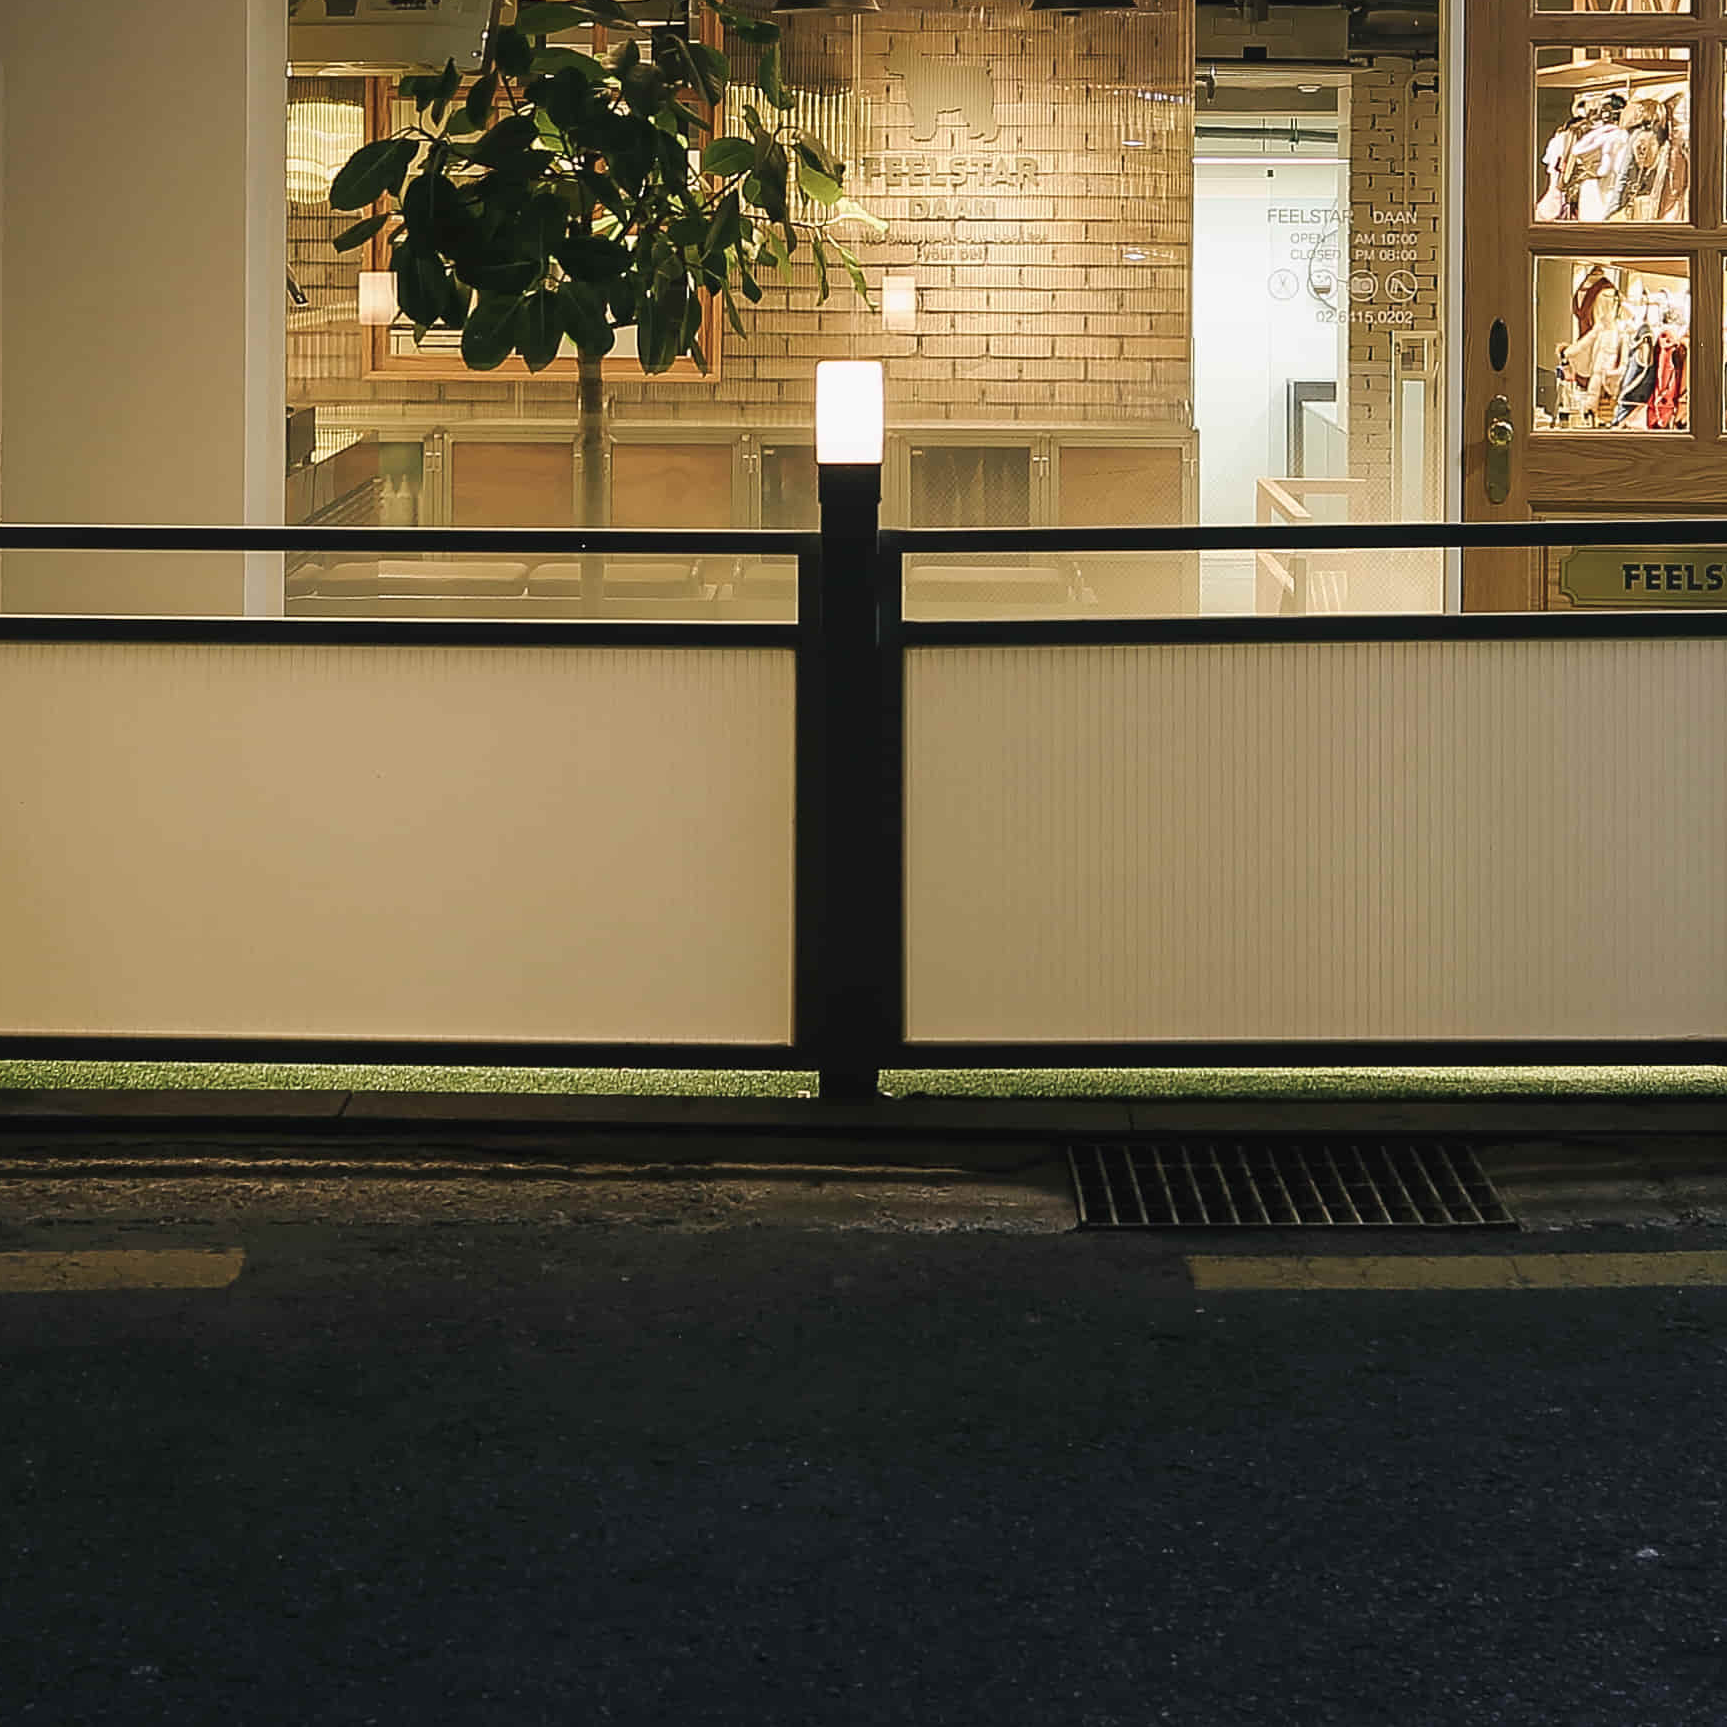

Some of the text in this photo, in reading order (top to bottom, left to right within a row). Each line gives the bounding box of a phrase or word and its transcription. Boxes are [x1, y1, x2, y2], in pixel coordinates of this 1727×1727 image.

[863, 157, 1040, 187] FEELSTAR
[908, 198, 996, 219] DAAN
[1267, 209, 1418, 224] FEELSTAR DAAN
[1290, 233, 1418, 245] OPEN AM 10:00
[1290, 249, 1418, 261] CLOSED PM 08:00
